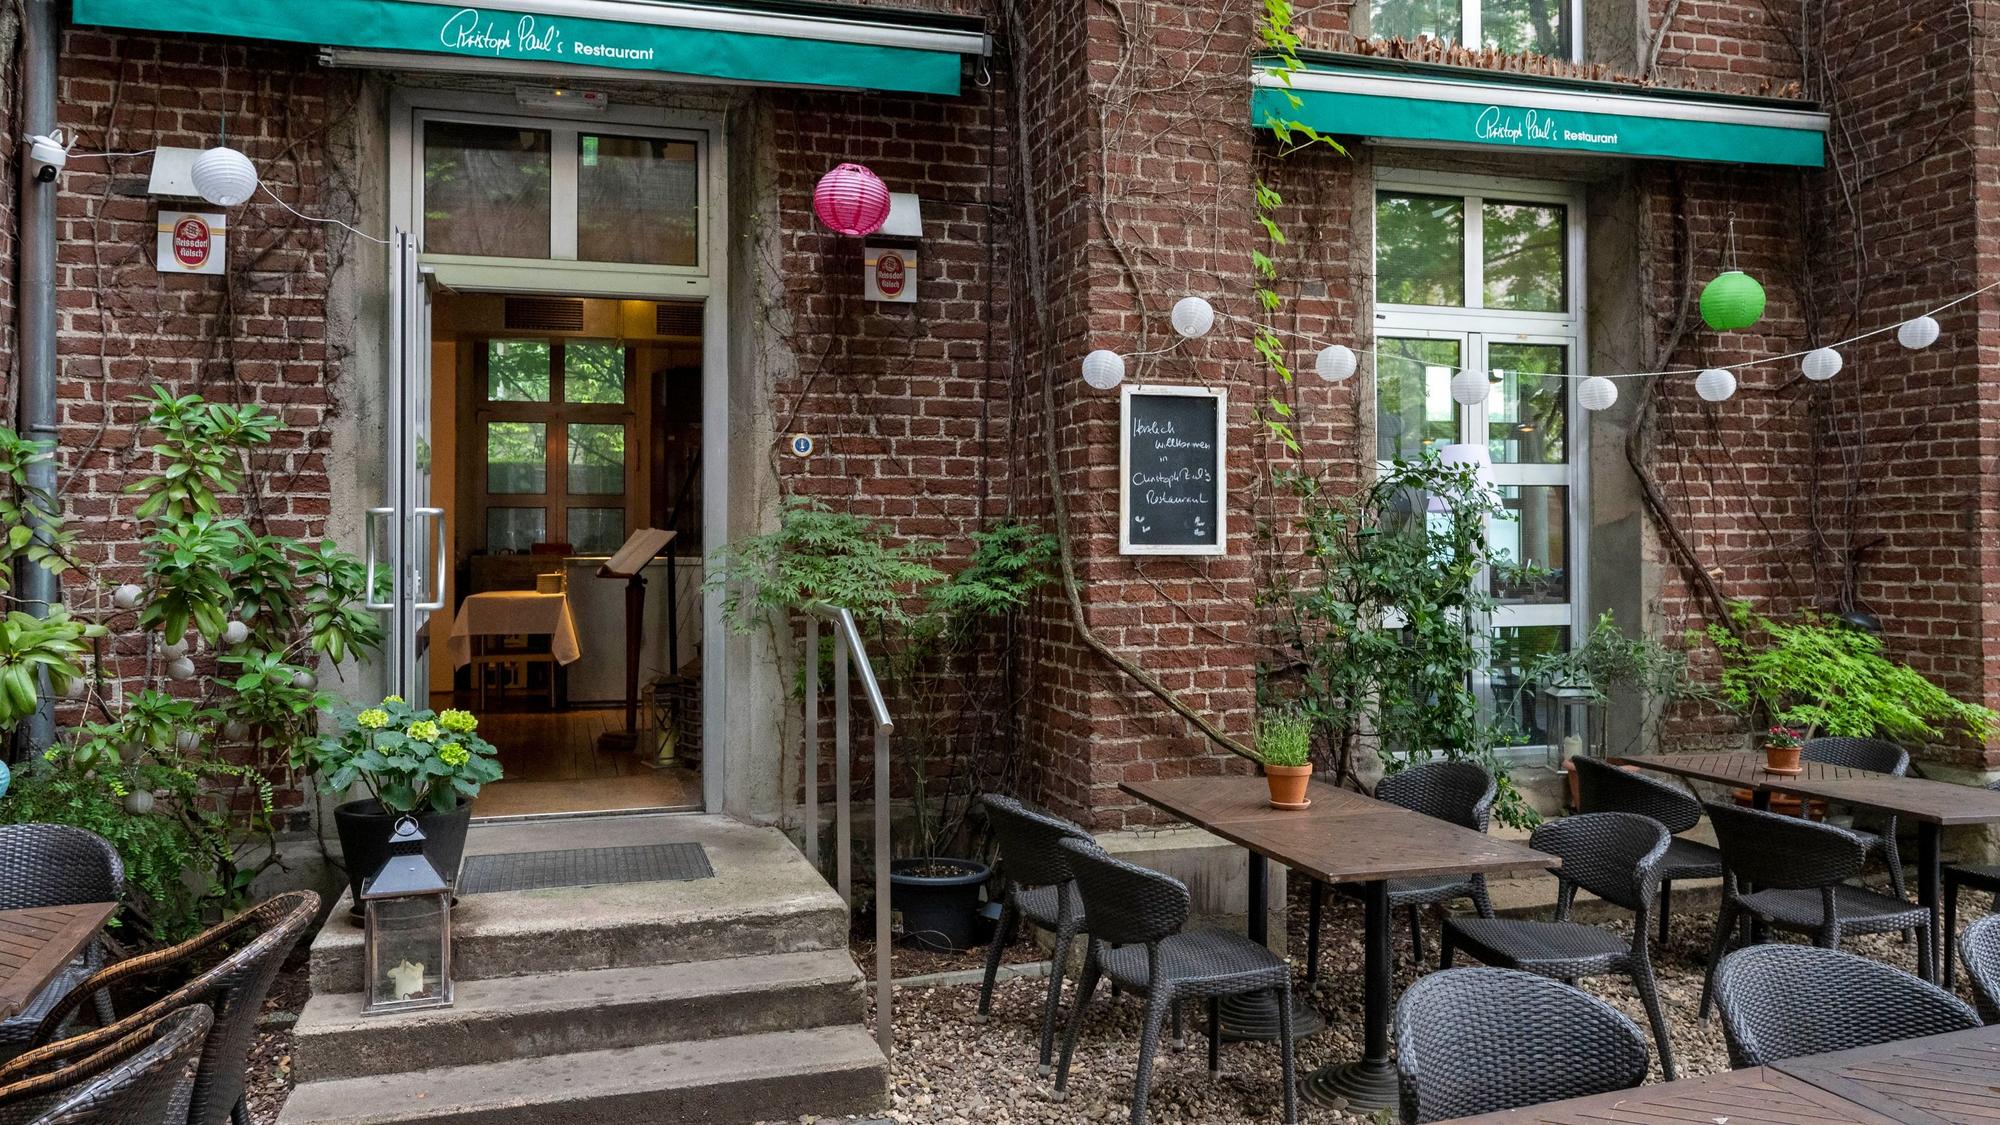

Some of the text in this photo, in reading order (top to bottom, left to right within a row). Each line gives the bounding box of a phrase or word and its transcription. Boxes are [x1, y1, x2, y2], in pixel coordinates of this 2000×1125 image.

[440, 9, 654, 60] Christoph Paul's Restaurant
[1475, 106, 1618, 144] Christoph Paul's Restaurant
[1132, 472, 1179, 488] Christoph
[1146, 489, 1208, 505] Restaurant
